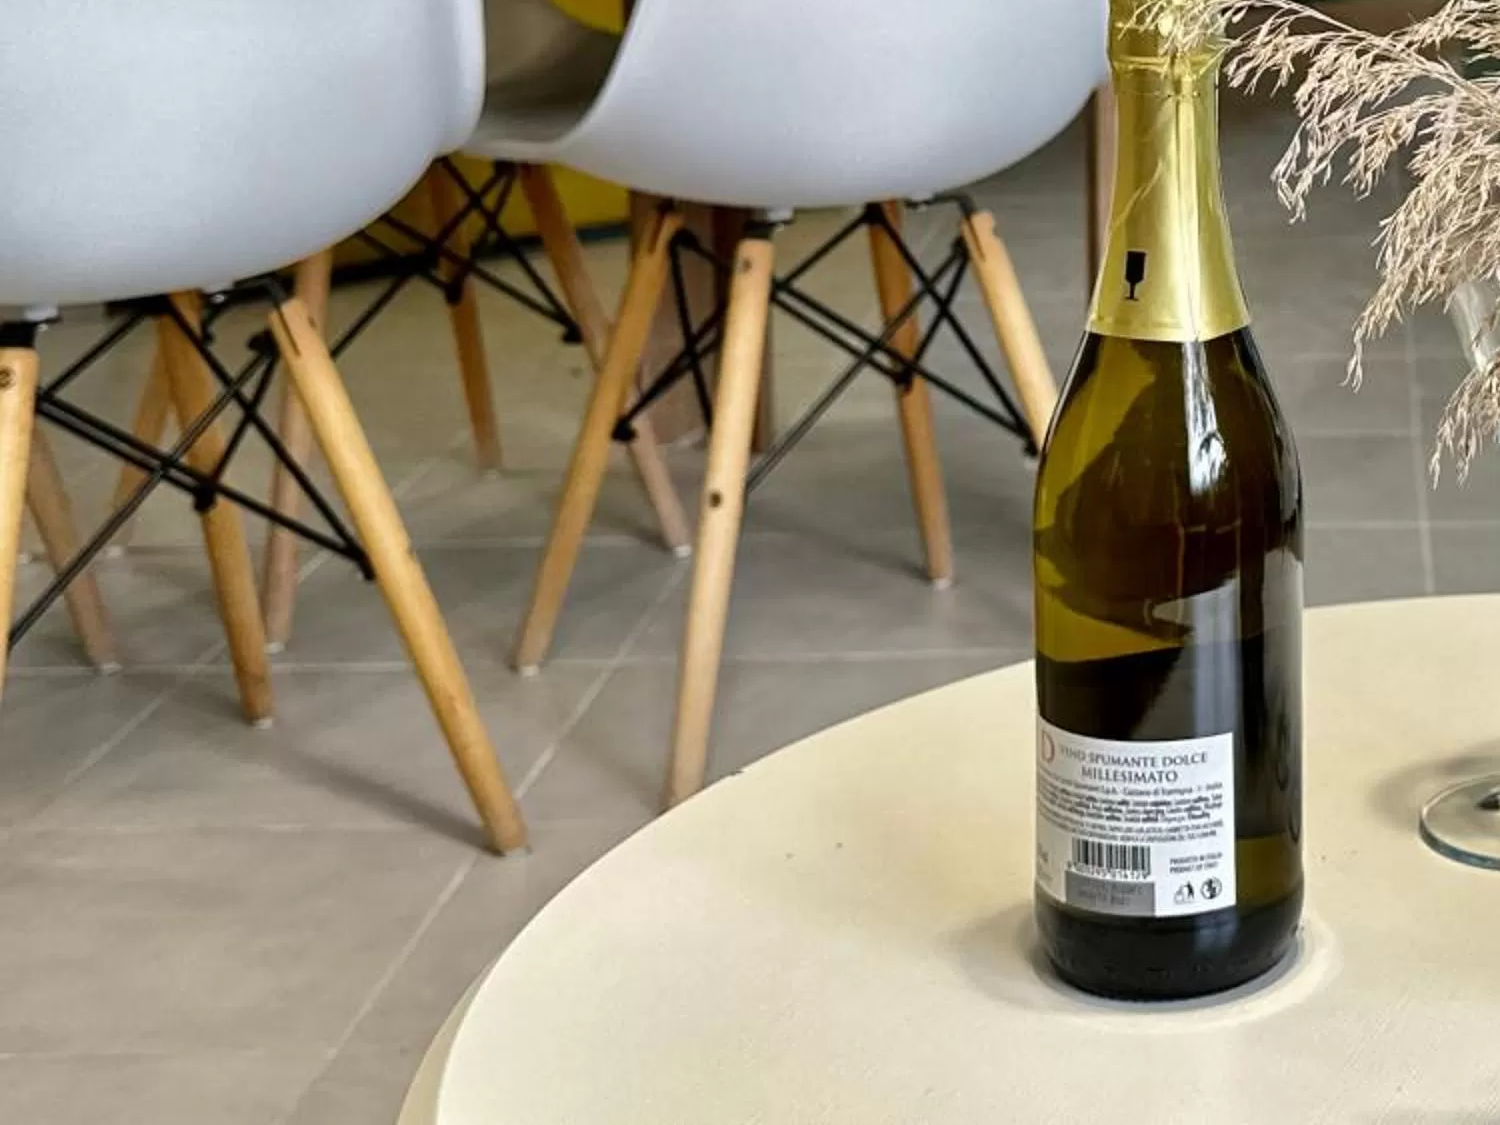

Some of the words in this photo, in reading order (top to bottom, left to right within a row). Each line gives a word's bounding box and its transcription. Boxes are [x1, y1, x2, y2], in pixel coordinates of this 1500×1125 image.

[1060, 745, 1086, 761] VINO
[1087, 750, 1158, 768] SPUMANTE
[1161, 751, 1208, 767] DOLCE
[1081, 766, 1179, 783] MILLESIMATO
